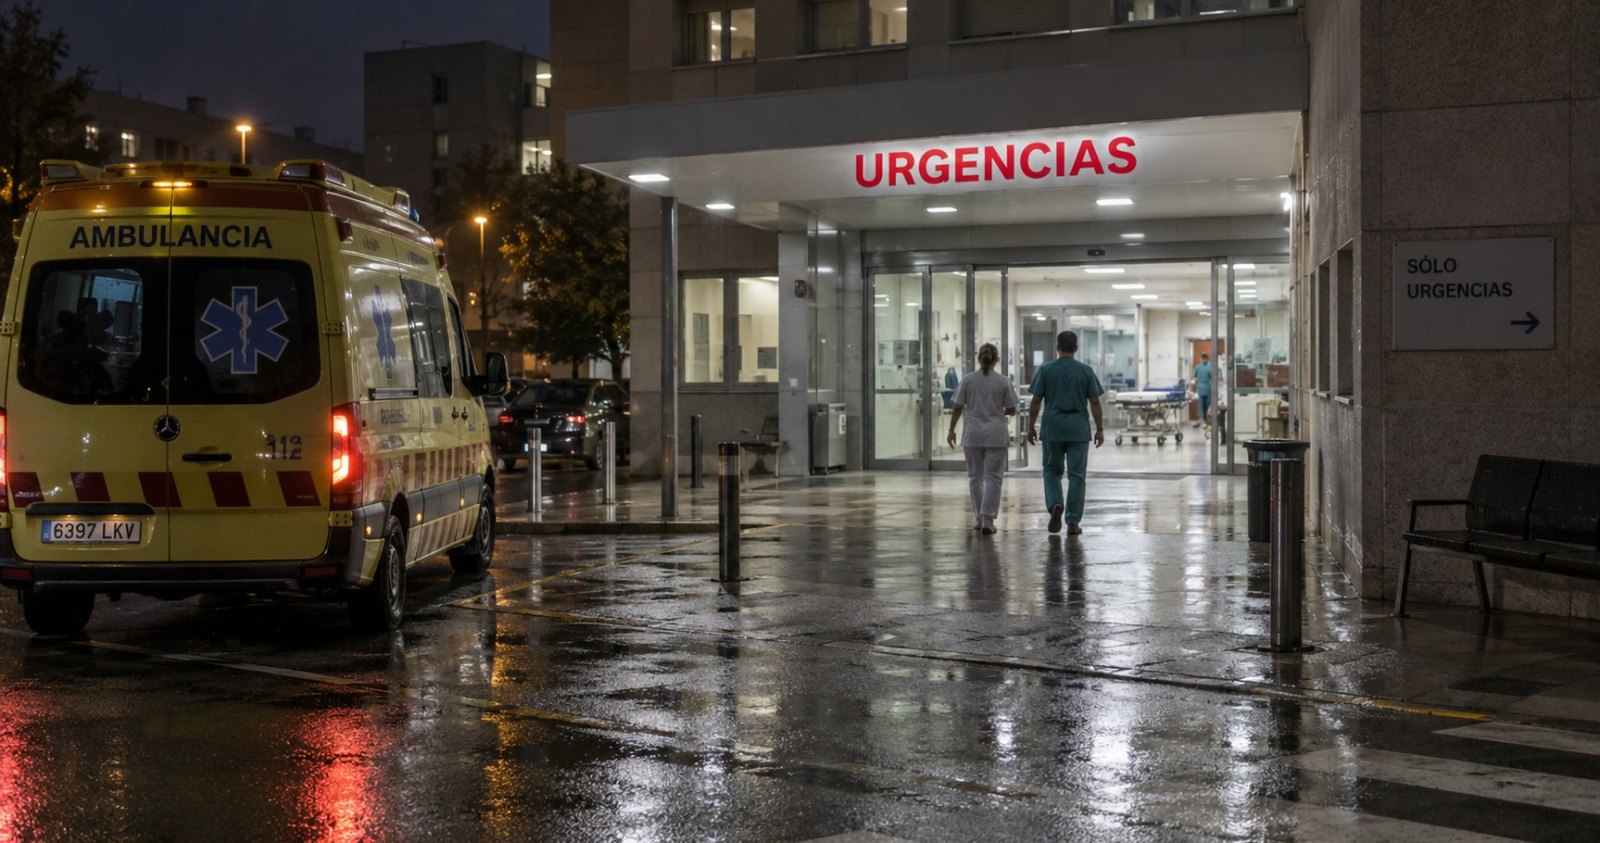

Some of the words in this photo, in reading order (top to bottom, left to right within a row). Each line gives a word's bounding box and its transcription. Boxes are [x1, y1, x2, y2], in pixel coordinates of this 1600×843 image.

[855, 136, 1138, 188] URGENCIAS
[69, 224, 273, 249] AMBULANCIA
[1407, 254, 1457, 274] SÓLO
[1407, 282, 1513, 299] URGENCIAS
[53, 523, 97, 539] 6397
[102, 523, 135, 539] LKV
